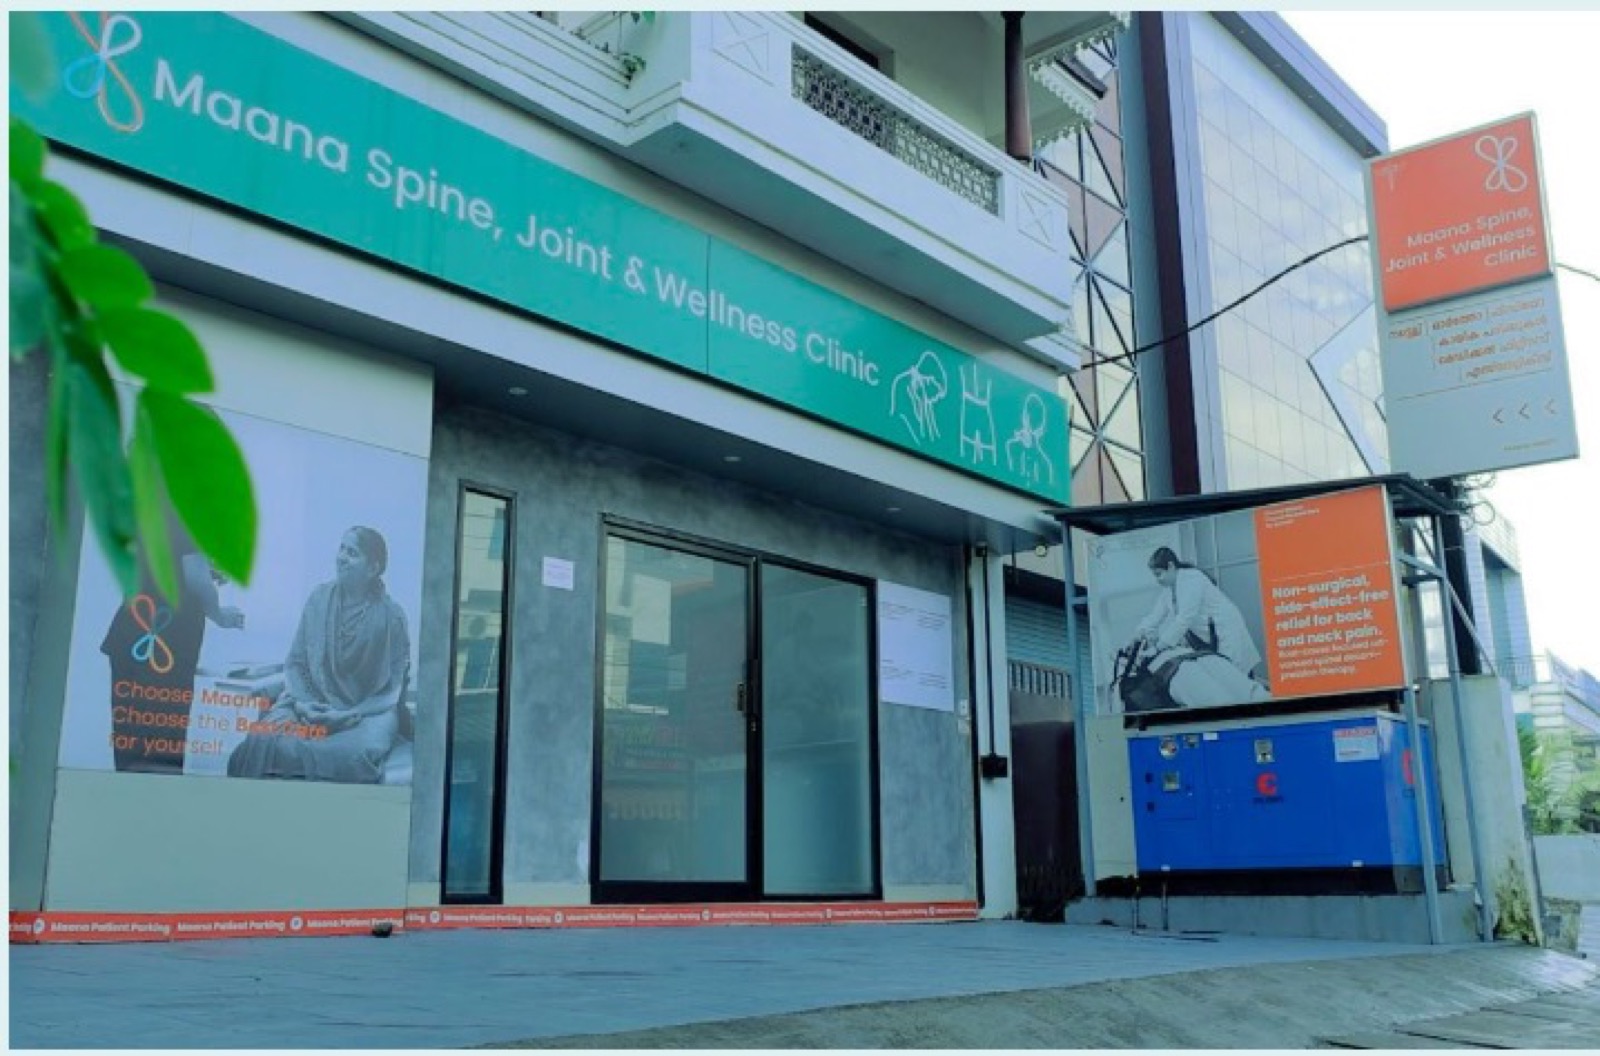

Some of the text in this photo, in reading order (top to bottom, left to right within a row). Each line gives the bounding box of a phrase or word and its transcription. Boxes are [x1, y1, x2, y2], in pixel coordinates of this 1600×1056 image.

[154, 59, 879, 387] Maana Spine, Joint & Wellness Clinic
[1408, 207, 1531, 248] Maana Spine,
[1386, 226, 1534, 273] Joint & Wellness
[1485, 245, 1536, 267] Clinic
[1273, 575, 1370, 599] Non-surgical,
[1275, 591, 1389, 615] side-effect-free
[1277, 609, 1372, 631] relief for back
[1278, 625, 1382, 647] and neck pain.
[115, 681, 273, 711] Choose Maana
[112, 705, 190, 728] Choose
[197, 712, 230, 731] the
[109, 732, 135, 751] for
